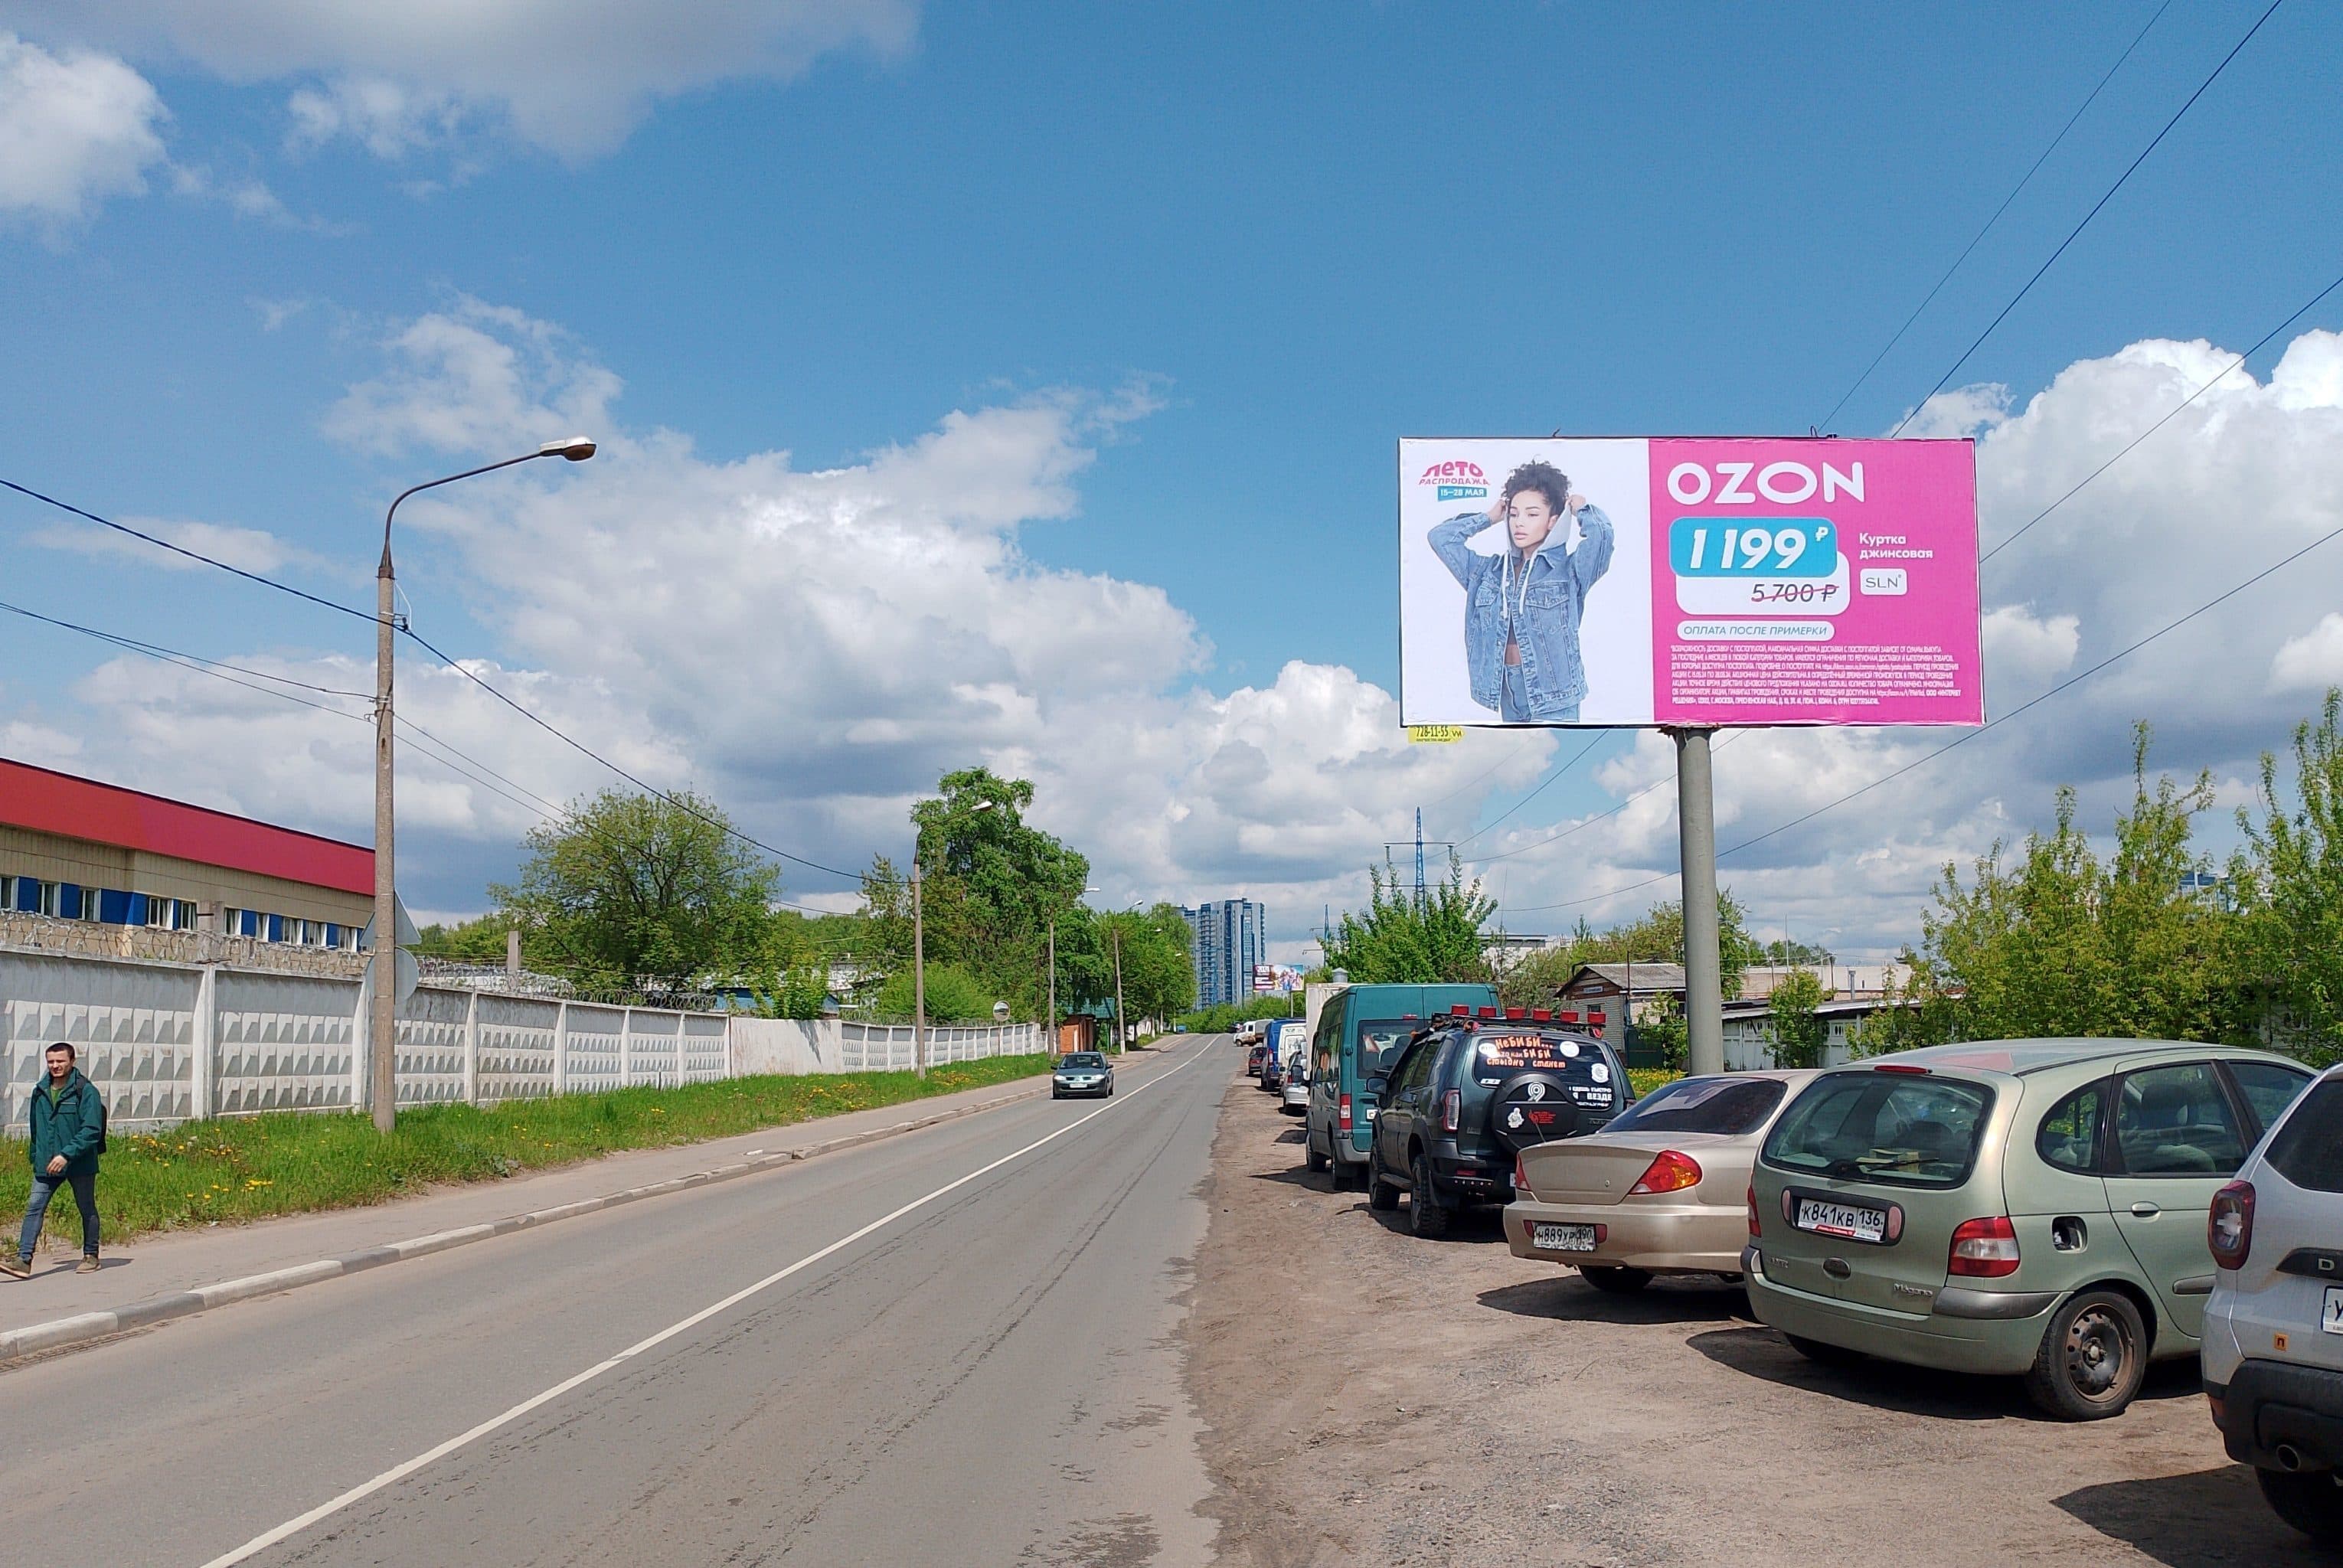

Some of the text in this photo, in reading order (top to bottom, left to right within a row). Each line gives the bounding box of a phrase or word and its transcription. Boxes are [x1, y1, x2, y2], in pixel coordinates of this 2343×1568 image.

[1667, 461, 1865, 505] OZON
[1464, 488, 1485, 497] МАЯ
[1859, 533, 1907, 547] Куртка
[1859, 550, 1933, 560] джинсовая
[1684, 626, 1828, 635] ОПЛАТА ПОСЛЕ ПРИМЕРКИ
[1532, 1060, 1566, 1069] станет
[1587, 1093, 1613, 1102] ВЕЗДЕ
[1859, 1210, 1881, 1227] 136
